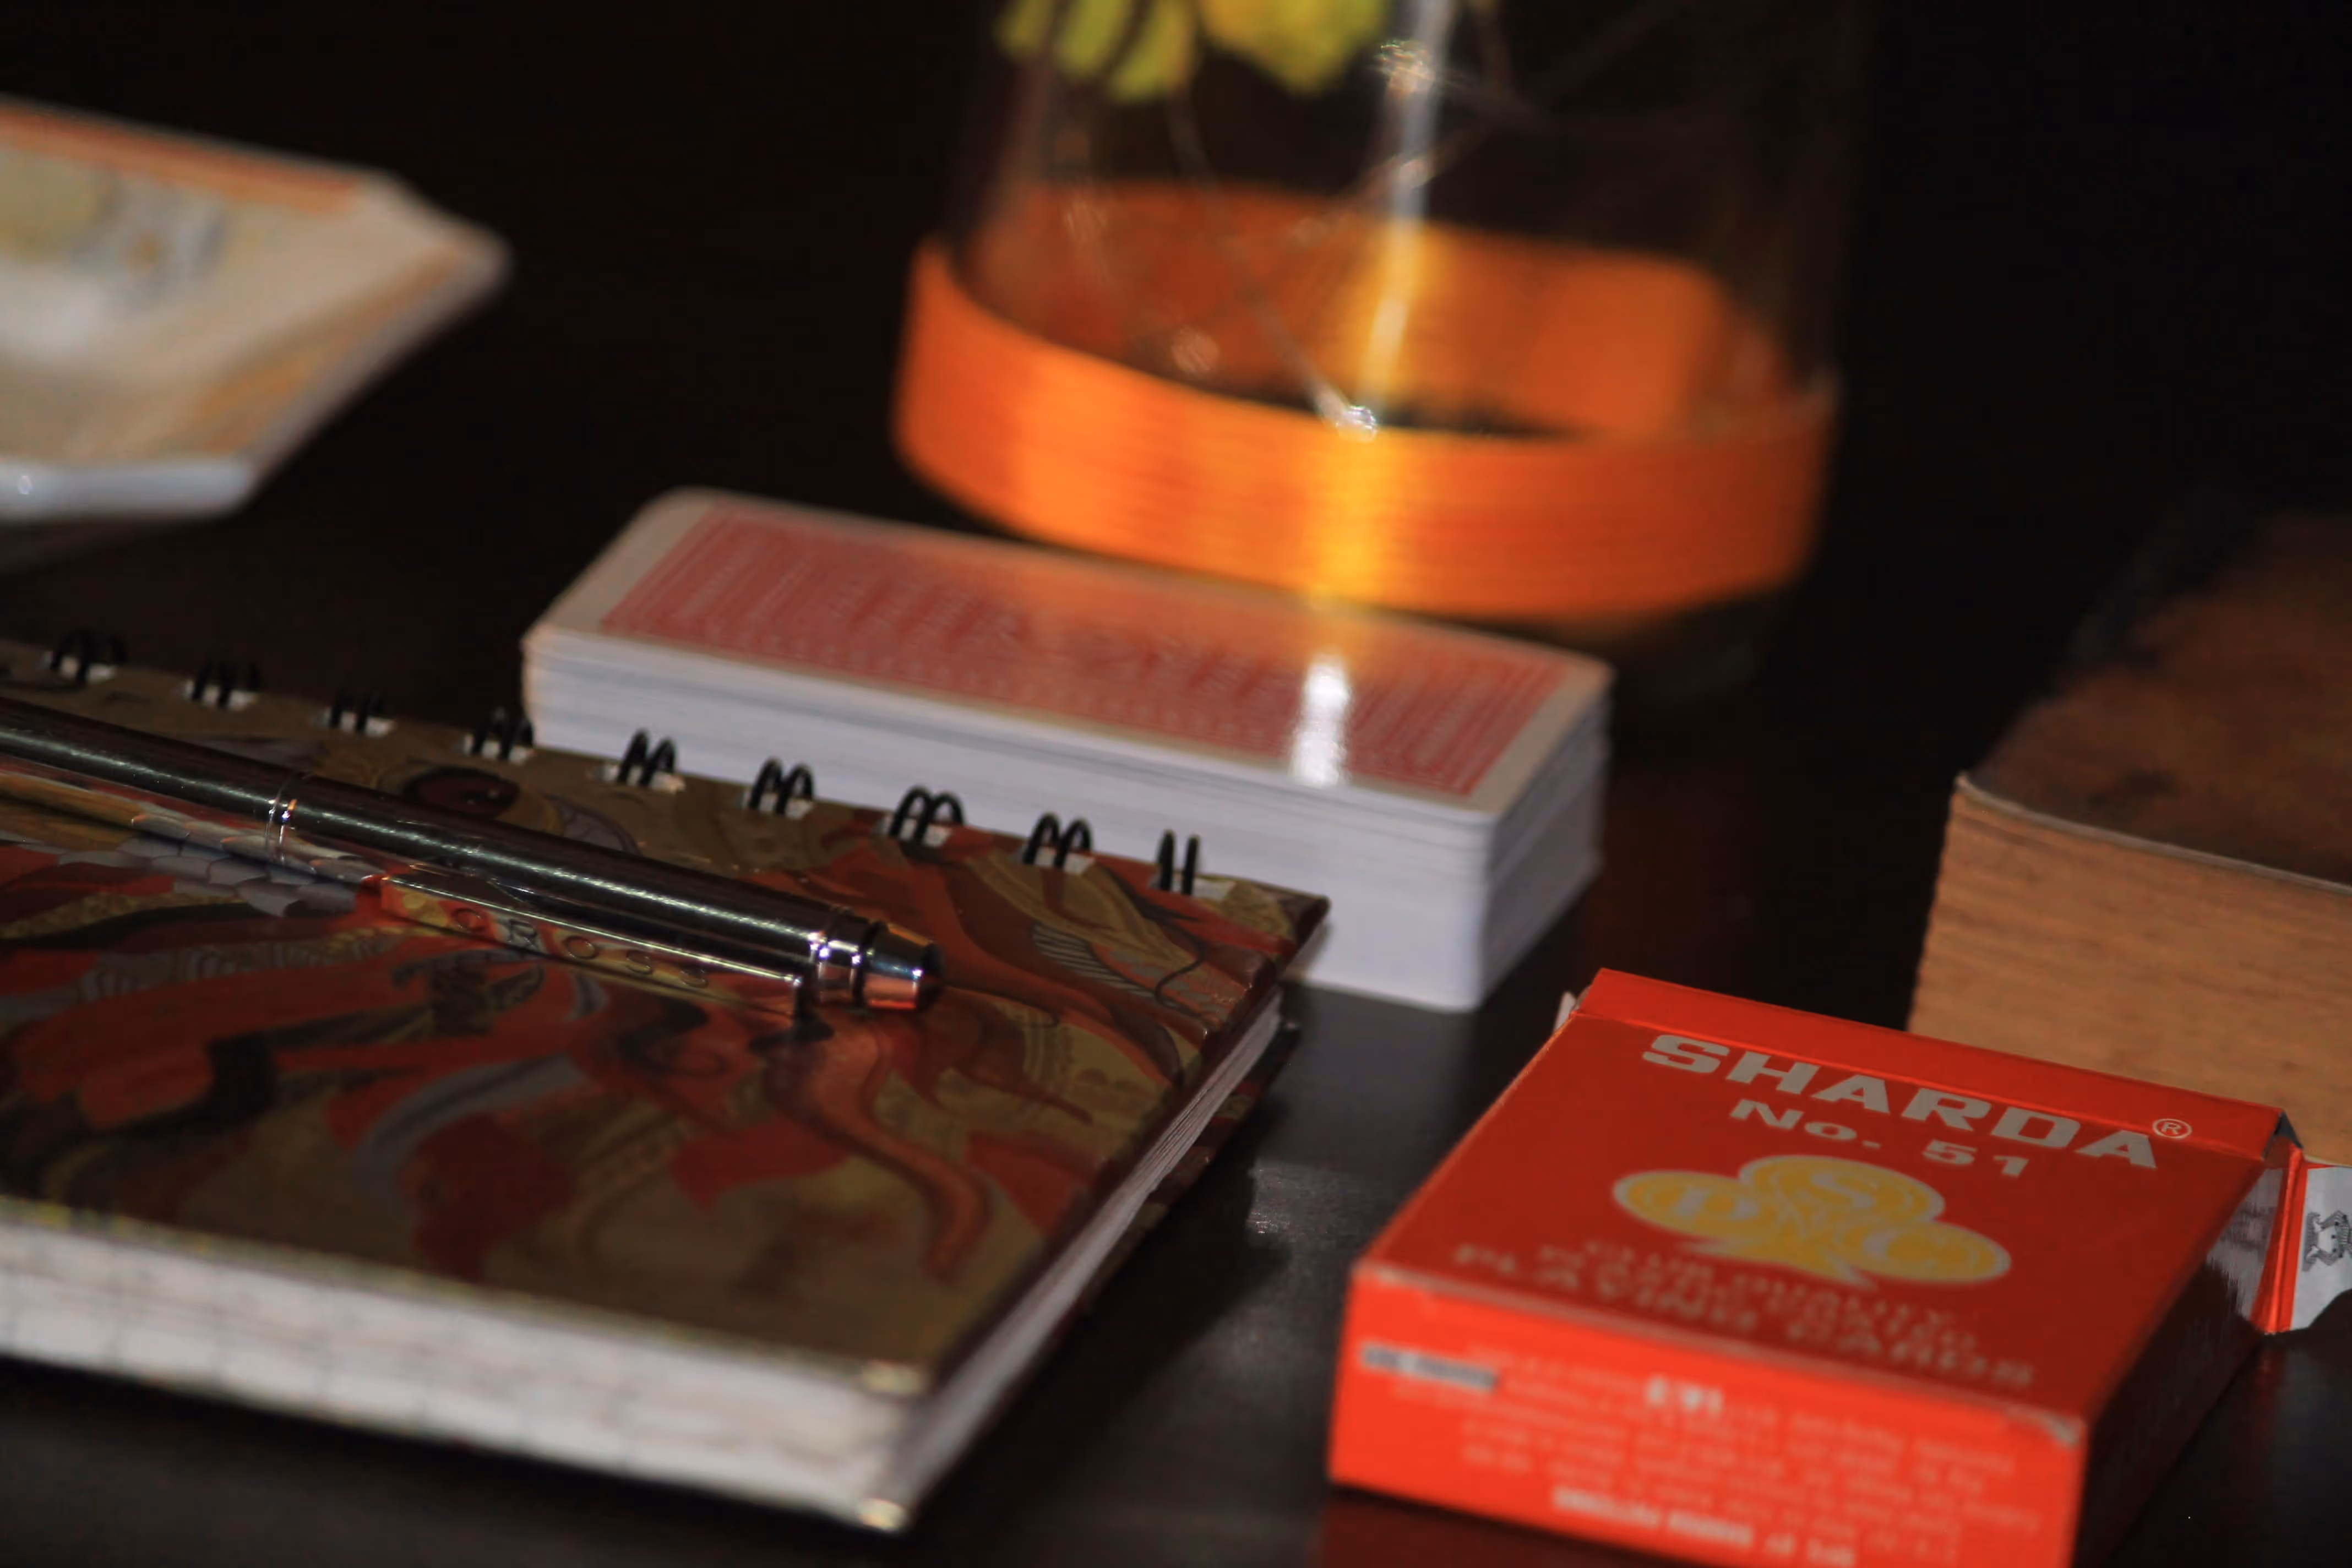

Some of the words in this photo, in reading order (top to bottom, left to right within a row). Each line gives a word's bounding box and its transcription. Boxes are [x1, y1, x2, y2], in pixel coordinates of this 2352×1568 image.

[451, 907, 708, 988] CROSS
[1641, 1034, 2157, 1169] SHARDA
[1729, 1099, 1881, 1150] No.
[1921, 1139, 2030, 1178] 51
